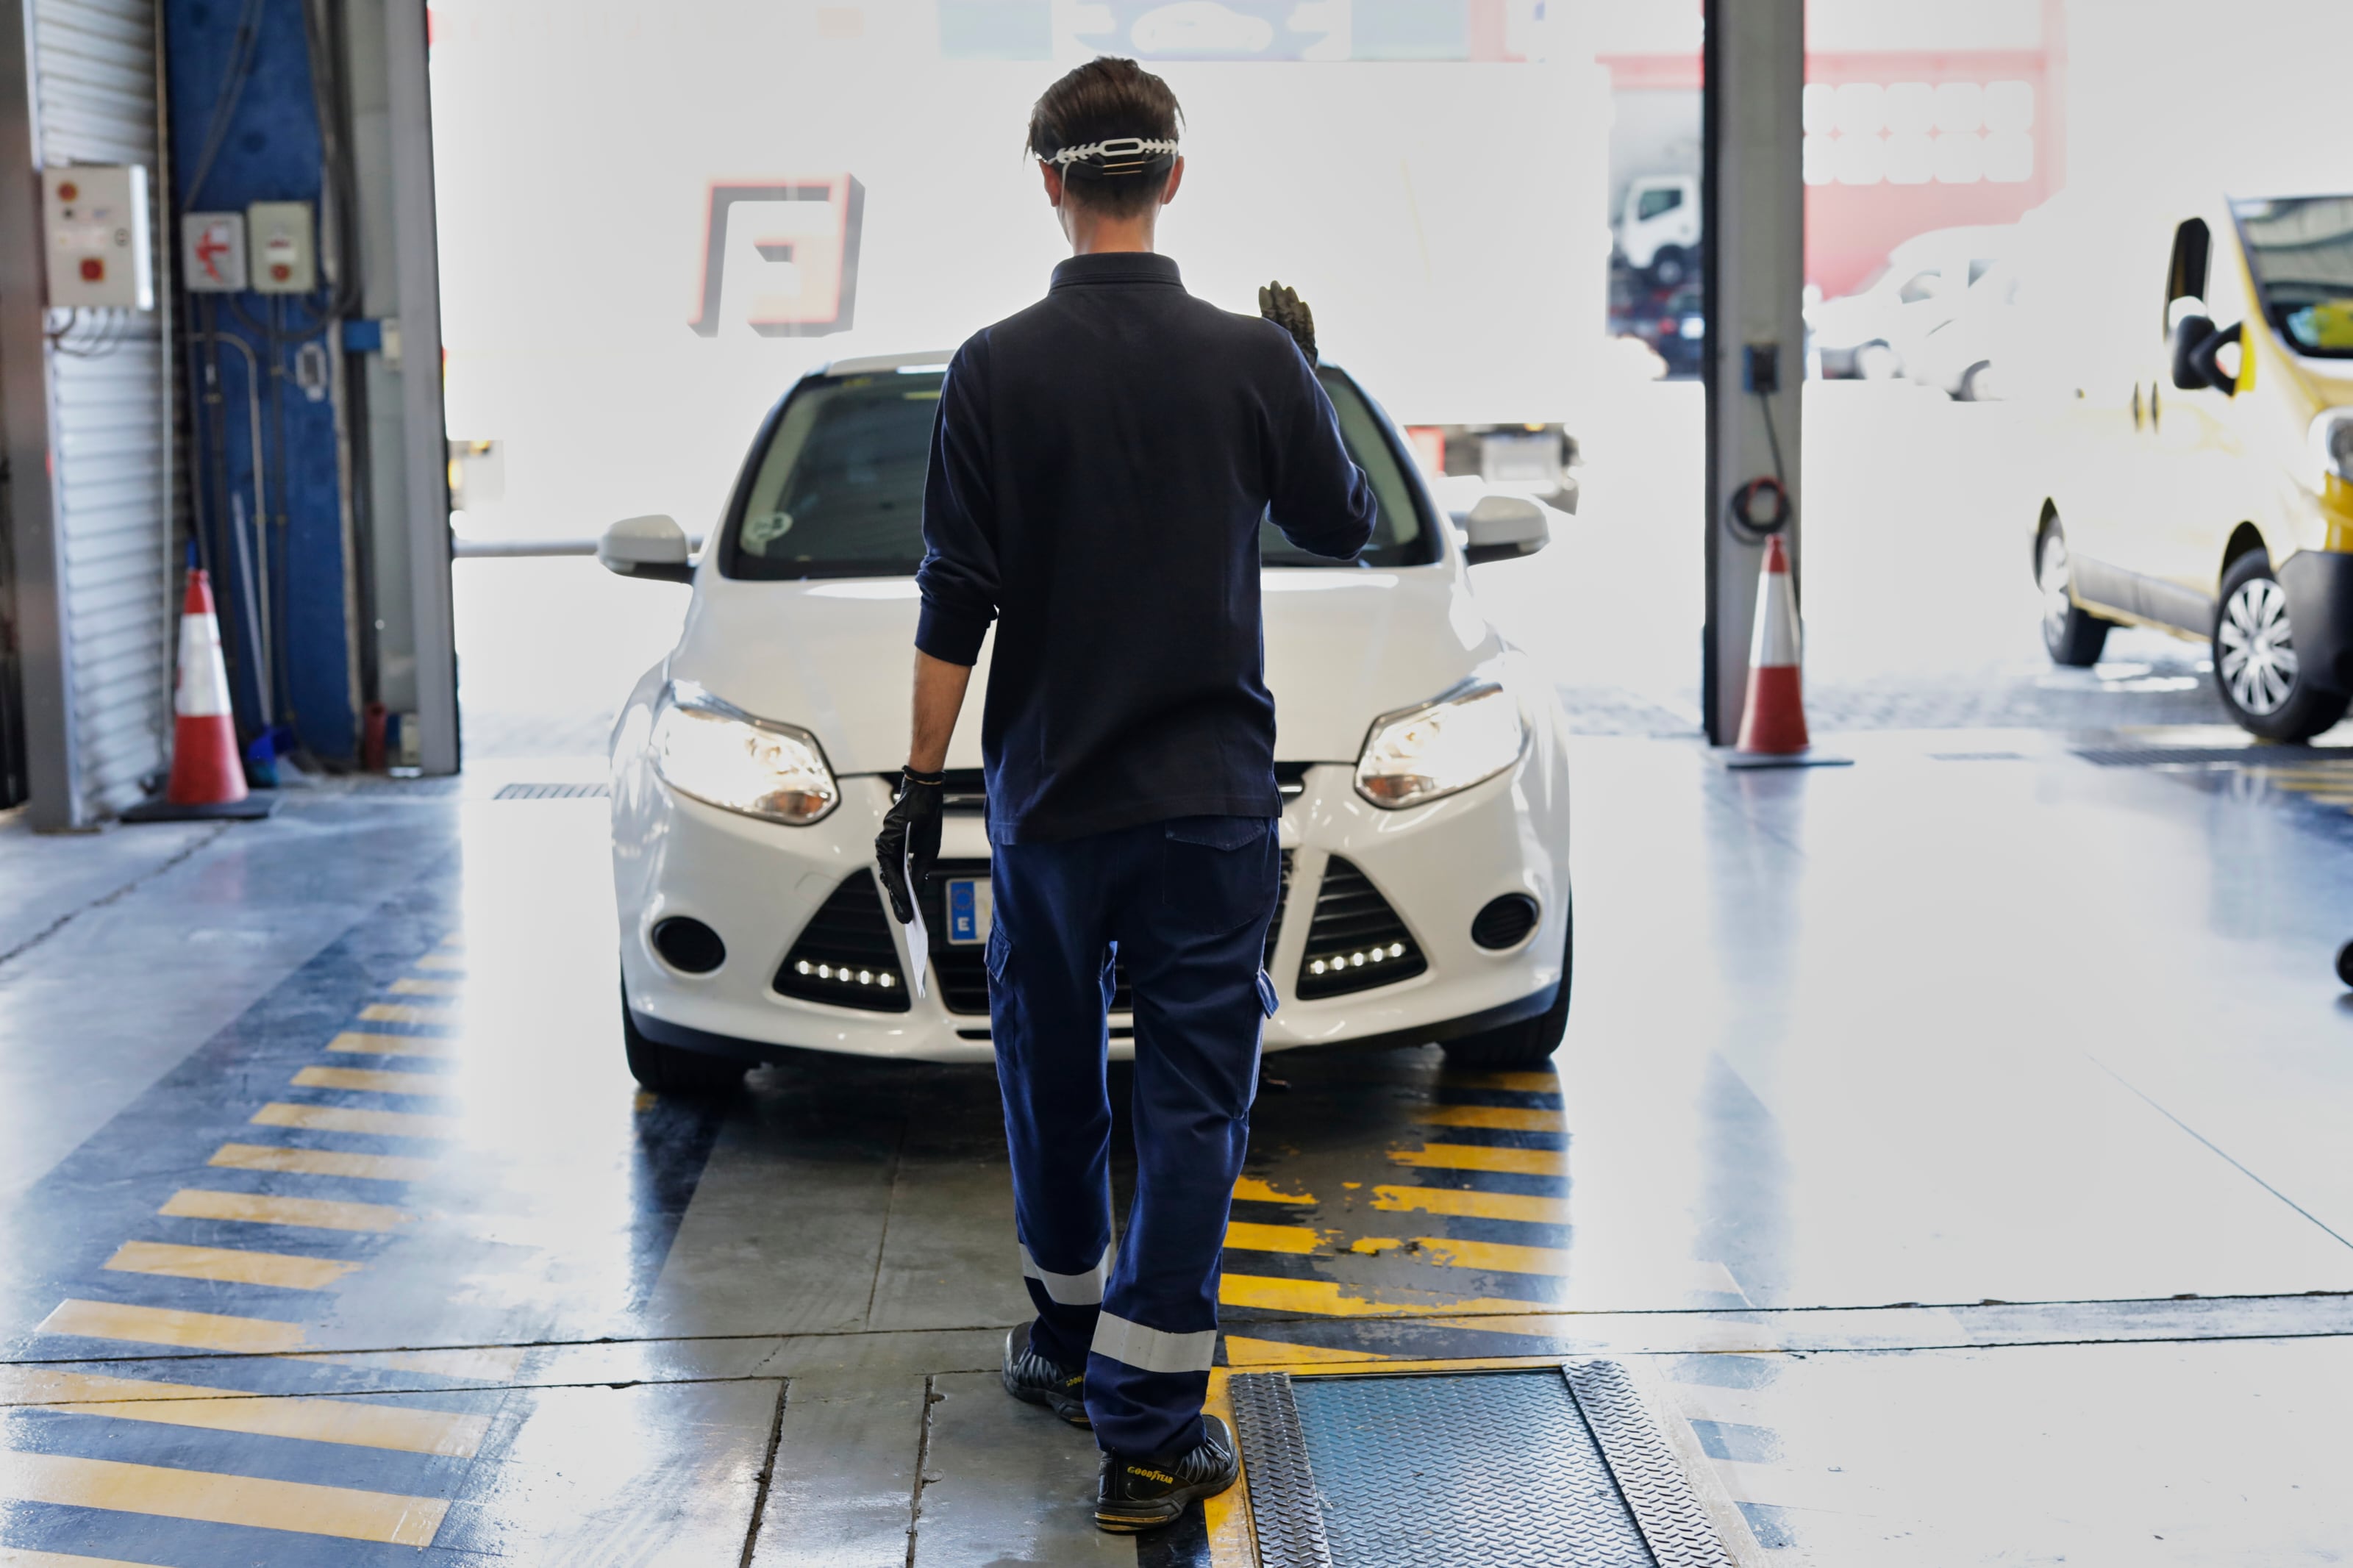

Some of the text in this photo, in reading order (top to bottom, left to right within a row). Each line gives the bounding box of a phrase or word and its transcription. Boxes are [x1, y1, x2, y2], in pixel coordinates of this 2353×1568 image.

[957, 917, 970, 931] E
[1065, 1375, 1085, 1387] GOOD
[1127, 1466, 1174, 1484] GOODYEAR
